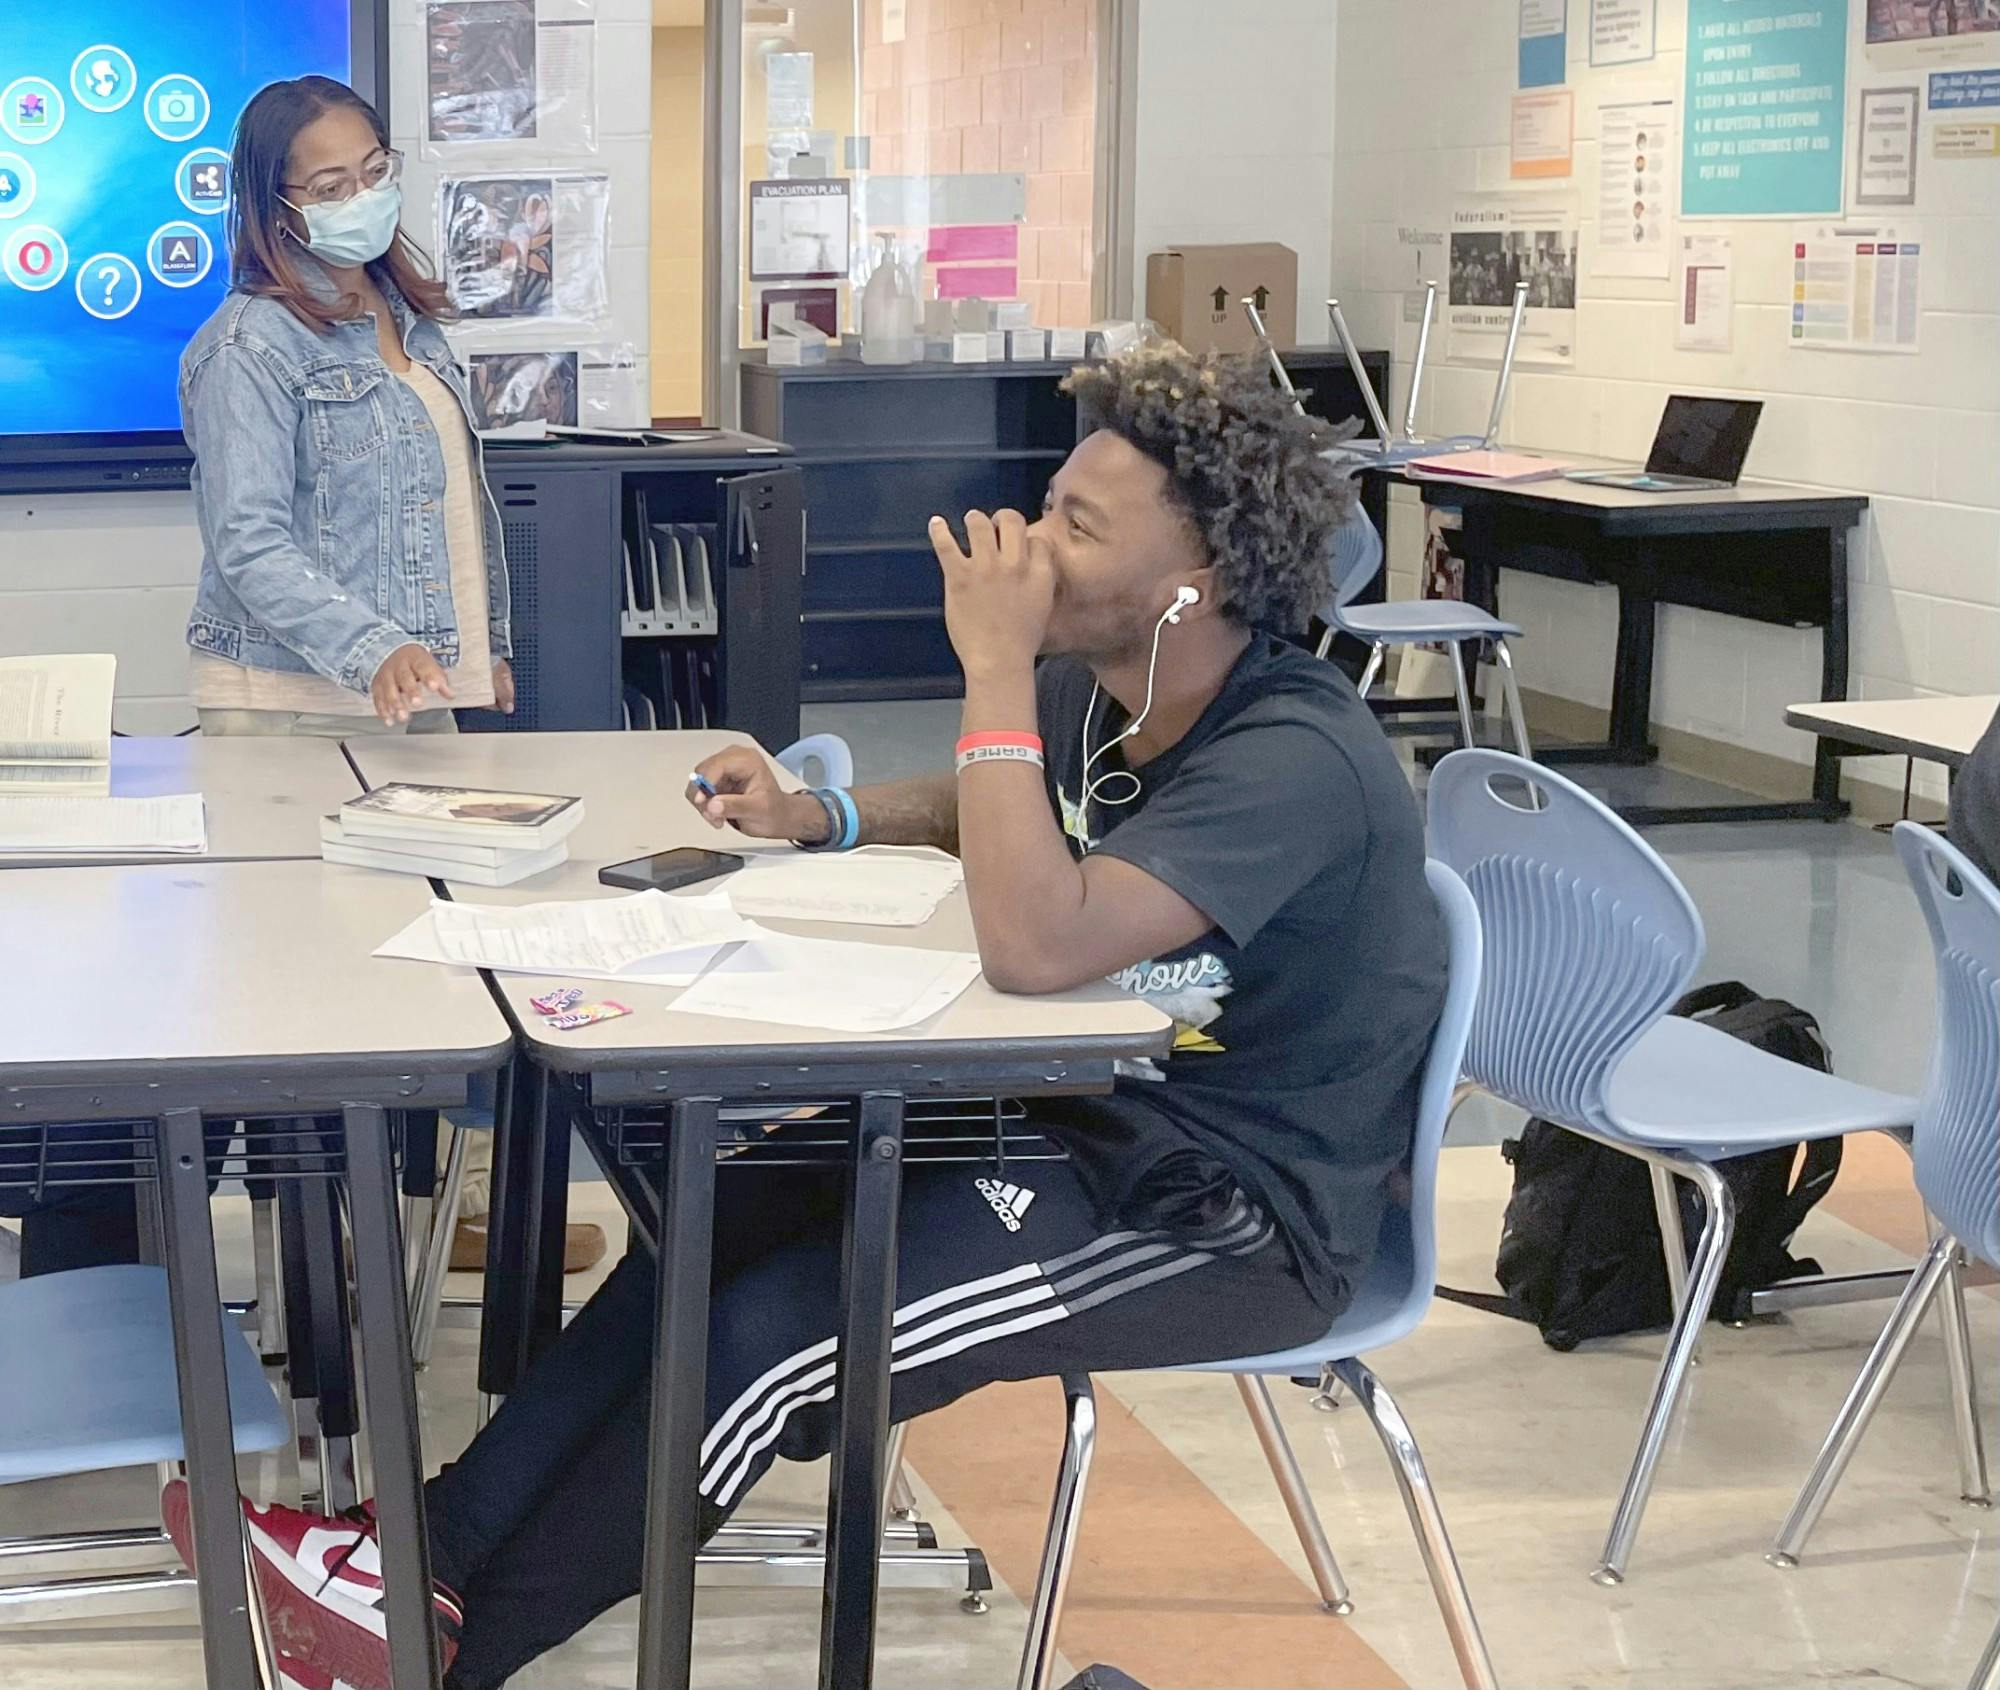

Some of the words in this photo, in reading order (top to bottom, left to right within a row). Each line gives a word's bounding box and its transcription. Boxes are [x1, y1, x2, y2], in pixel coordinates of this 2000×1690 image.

[1703, 47, 1725, 62] UPON
[1726, 43, 1751, 60] ENTRY
[761, 184, 817, 197] EVACUATION
[818, 184, 842, 195] PLAN
[1398, 228, 1444, 246] Welcome
[1211, 313, 1227, 324] UP
[966, 747, 1028, 761] GAMER
[974, 1178, 1021, 1232] adidas
